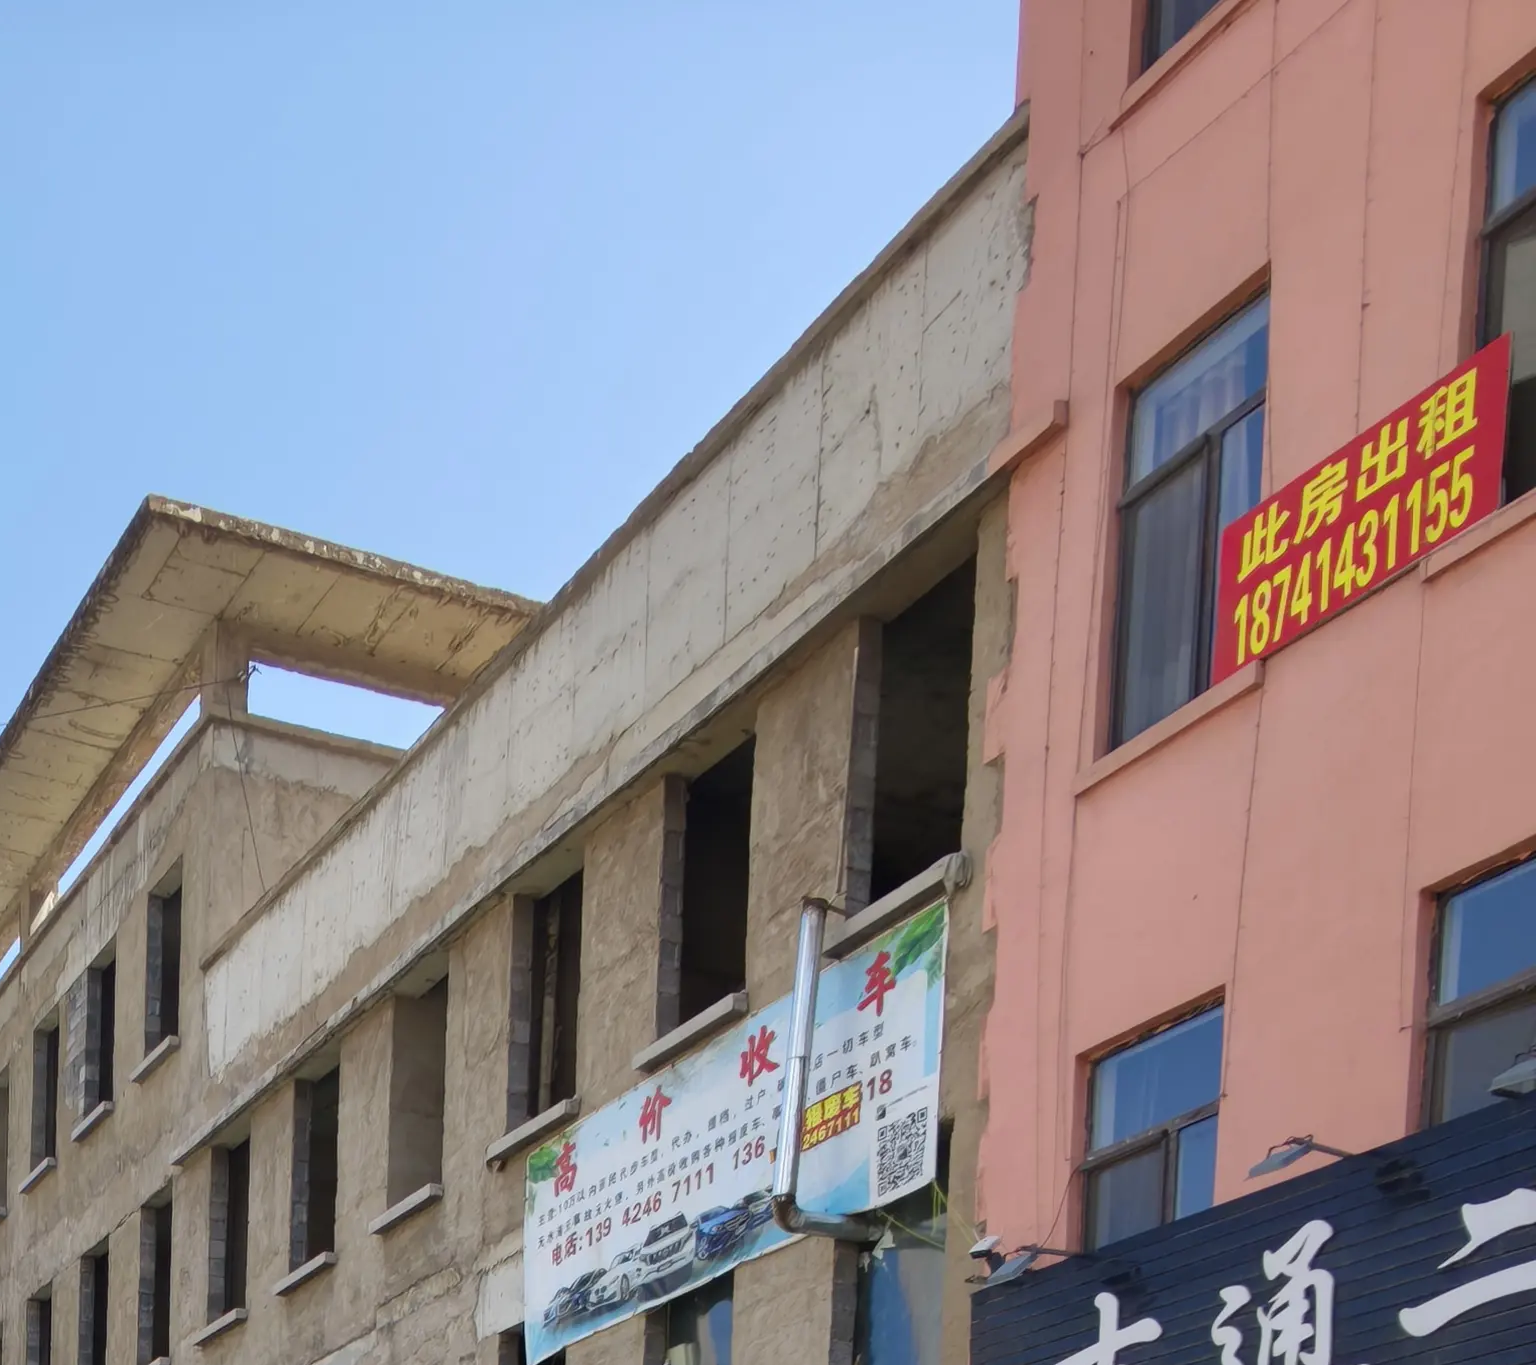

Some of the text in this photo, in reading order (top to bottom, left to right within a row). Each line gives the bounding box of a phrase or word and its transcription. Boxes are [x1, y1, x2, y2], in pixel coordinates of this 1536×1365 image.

[1233, 445, 1475, 666] 18741431155
[1237, 367, 1477, 583] 此房出租
[552, 951, 897, 1198] 高价收车
[622, 1190, 662, 1227] 4246
[671, 1162, 715, 1203] 7111
[732, 1135, 766, 1171] 136
